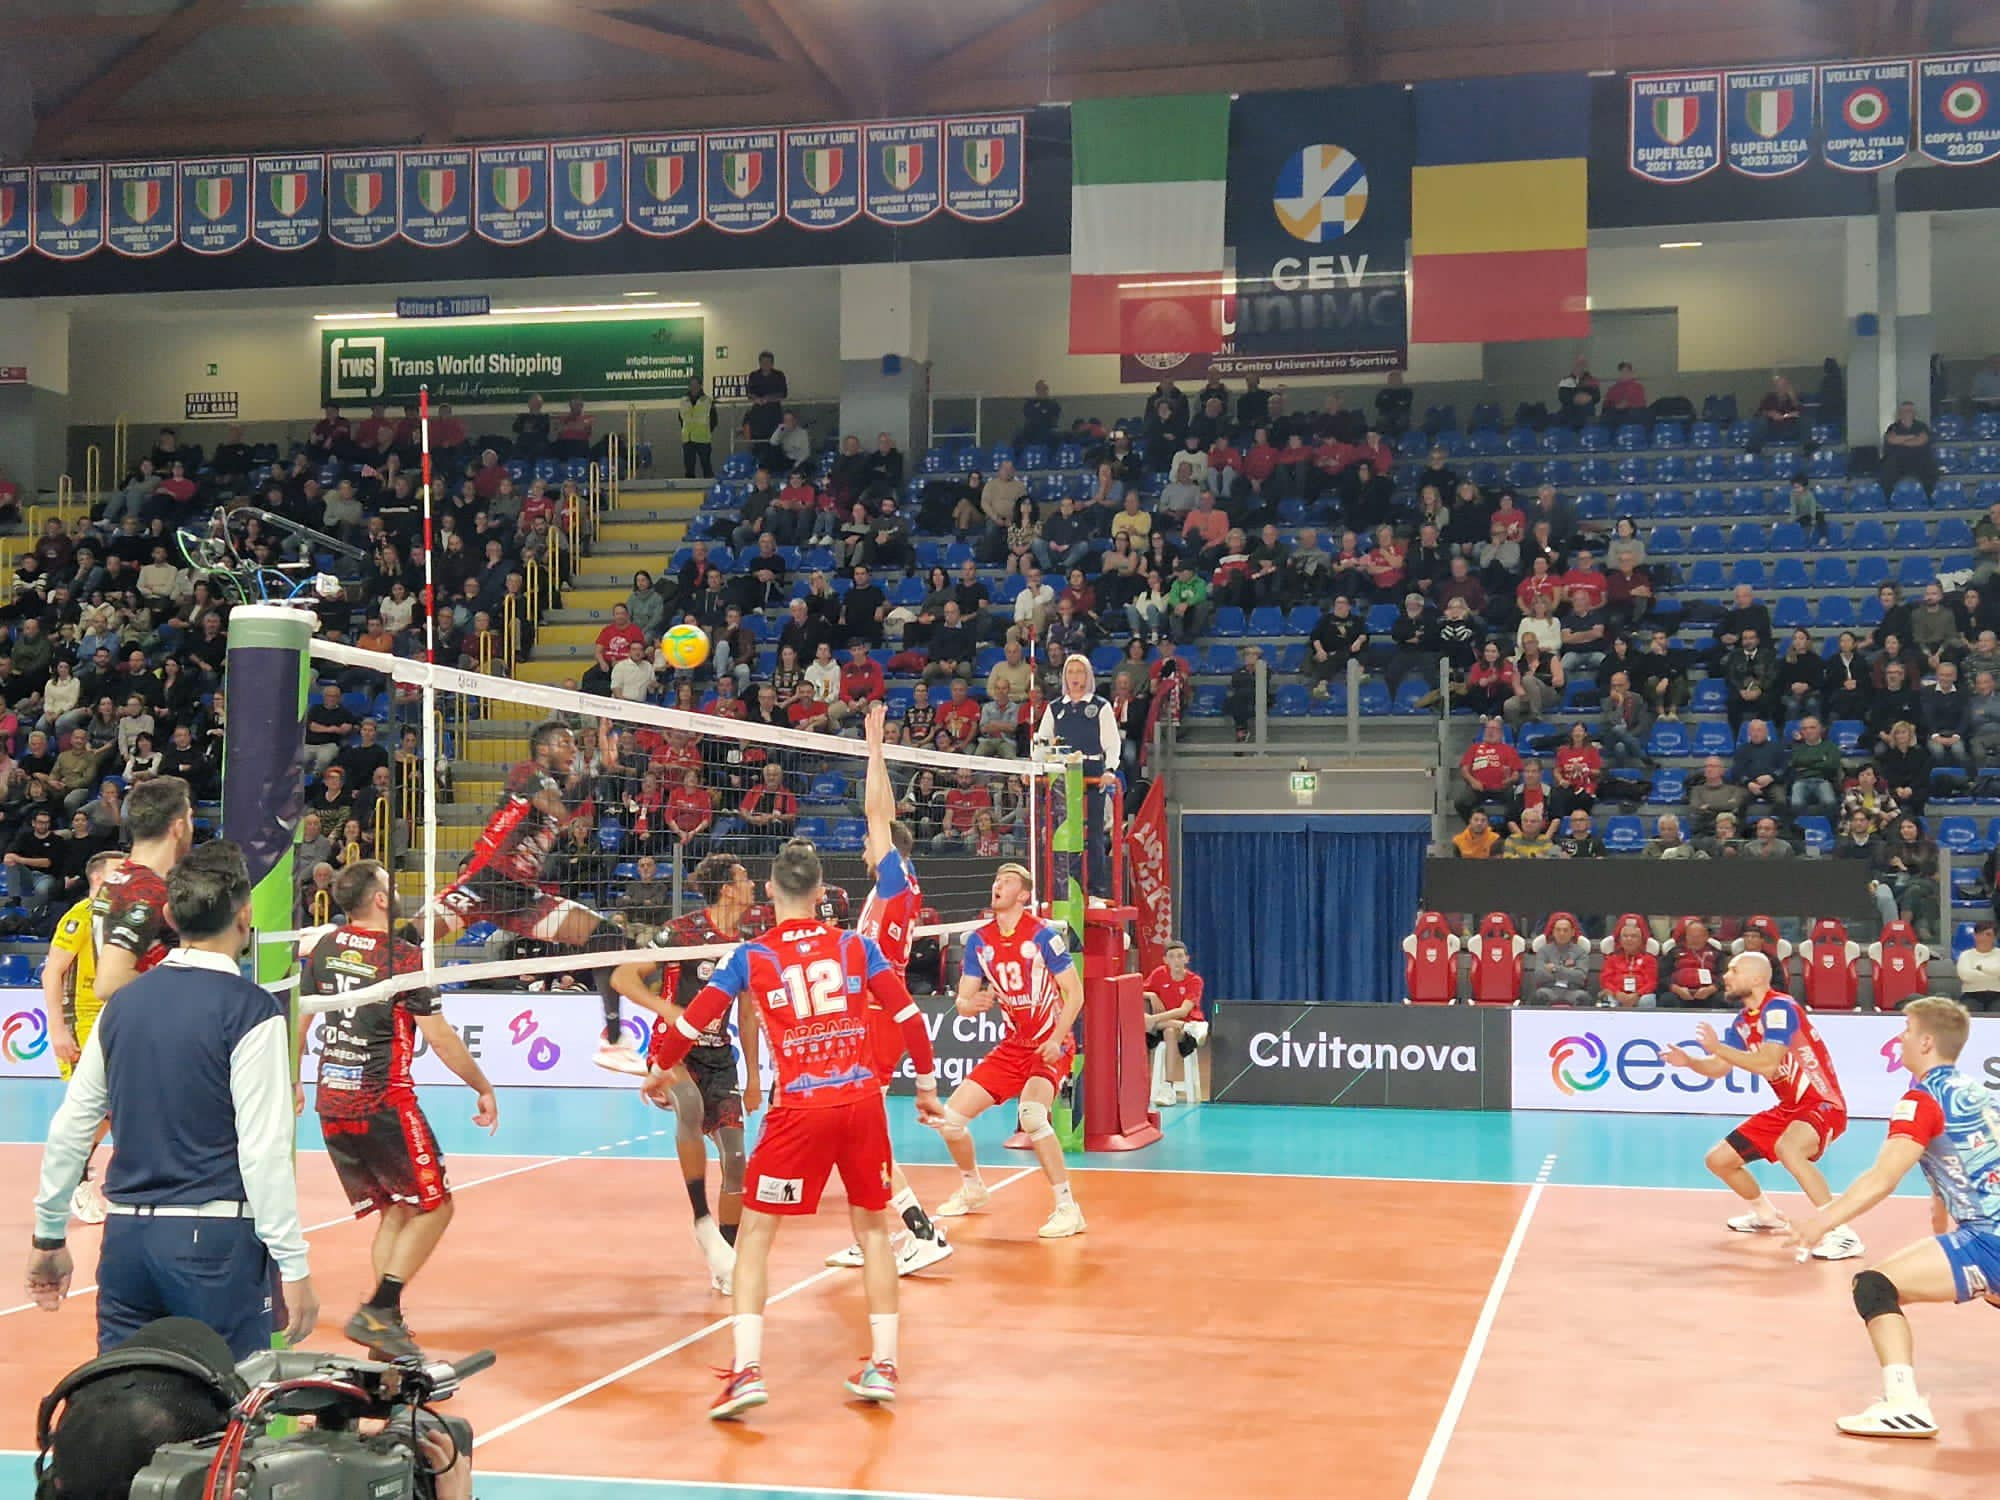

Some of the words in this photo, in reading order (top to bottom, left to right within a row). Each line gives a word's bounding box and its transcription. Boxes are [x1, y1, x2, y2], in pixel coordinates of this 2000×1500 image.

[1826, 70, 1871, 83] VOLLEY
[1875, 66, 1907, 79] LUBE
[1924, 63, 1969, 76] VOLLEY
[1637, 82, 1681, 95] VOLLEY
[1685, 79, 1715, 93] LUBE
[1730, 75, 1774, 89] VOLLEY
[1779, 72, 1809, 86] LUBE
[869, 129, 905, 142] VOLLEY
[909, 126, 937, 139] LUBE
[950, 124, 988, 137] VOLLEY
[991, 122, 1018, 135] LUBE
[709, 137, 746, 150] VOLLEY
[749, 135, 775, 148] LUBE
[789, 134, 825, 147] VOLLEY
[829, 131, 856, 145] LUBE
[1827, 138, 1866, 151] COPPA
[1868, 135, 1905, 147] ITALIA
[1925, 132, 1963, 145] COPPA
[556, 148, 591, 161] VOLLEY
[594, 145, 620, 157] LUBE
[632, 142, 668, 155] VOLLEY
[671, 140, 697, 153] LUBE
[1637, 145, 1713, 161] SUPERLEGA
[1730, 138, 1808, 156] SUPERLEGA
[1947, 143, 1985, 156] 2020
[332, 158, 367, 169] VOLLEY
[405, 155, 442, 167] VOLLEY
[443, 153, 469, 165] LUBE
[480, 152, 516, 164] VOLLEY
[518, 150, 544, 162] LUBE
[979, 153, 989, 169] J
[1740, 155, 1769, 166] 2020
[1771, 153, 1798, 165] 2021
[1848, 149, 1884, 163] 2021
[111, 168, 145, 179] VOLLEY
[148, 166, 173, 177] LUBE
[184, 165, 218, 177] VOLLEY
[221, 163, 246, 174] LUBE
[257, 161, 293, 173] VOLLEY
[295, 159, 320, 171] LUBE
[1646, 161, 1672, 172] 2021
[1676, 159, 1705, 171] 2022
[423, 227, 449, 239] 2007
[575, 220, 603, 232] 2007
[1271, 254, 1369, 292] CEV
[340, 357, 375, 378] TWS
[389, 356, 435, 377] Trans
[436, 353, 485, 376] World
[488, 352, 562, 377] Shipping
[1235, 361, 1273, 373] Centro
[1274, 356, 1347, 371] Universitario
[1349, 355, 1399, 370] Sportivo
[605, 367, 694, 381] www.twsonline.it
[995, 960, 1025, 992] 13
[781, 958, 849, 1020] 12
[1249, 1031, 1477, 1073] Civitanova
